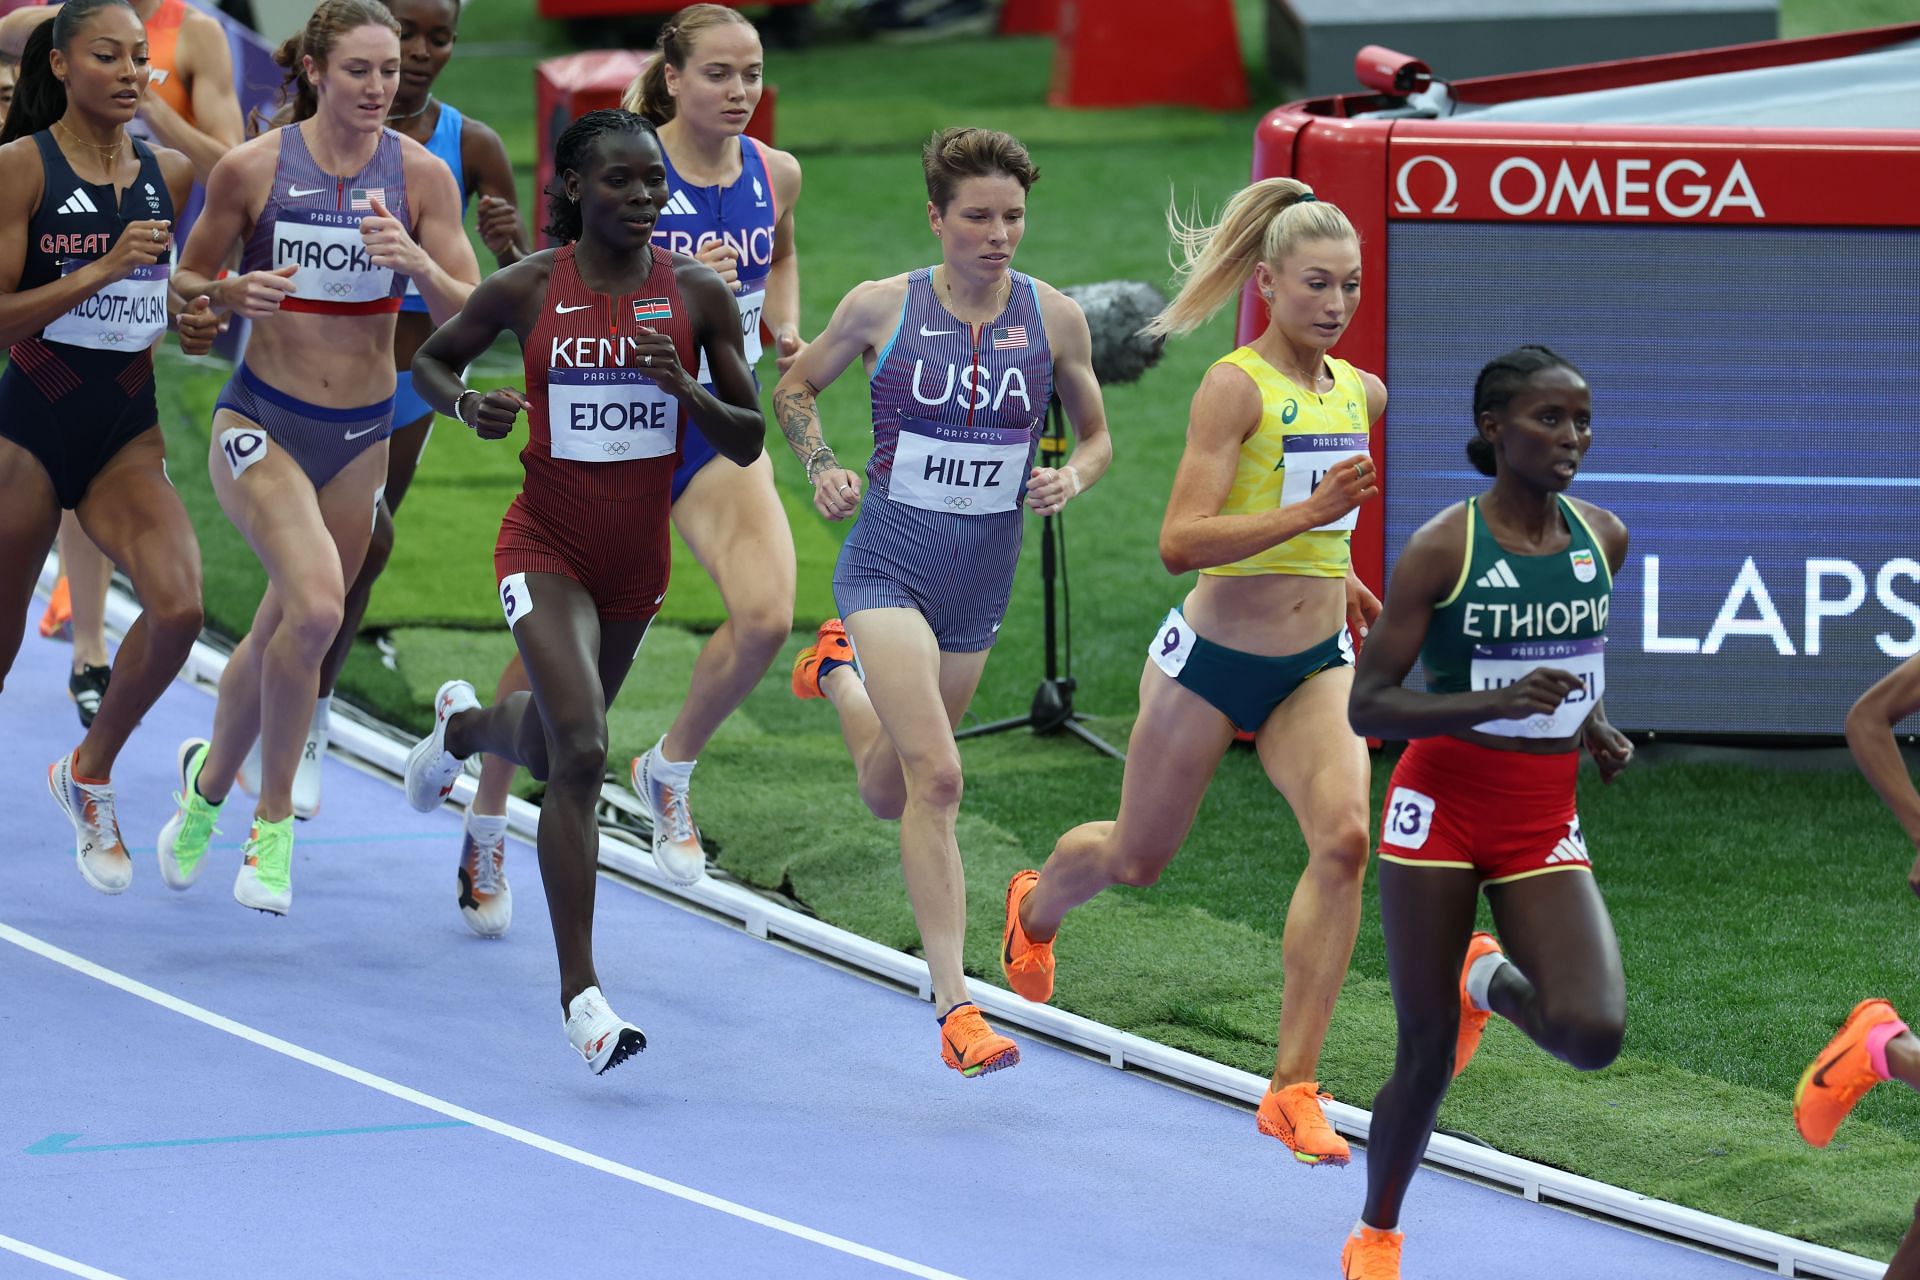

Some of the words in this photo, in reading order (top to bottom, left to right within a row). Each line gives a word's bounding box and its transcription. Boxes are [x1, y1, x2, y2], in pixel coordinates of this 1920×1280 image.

[1489, 156, 1766, 218] OMEGA
[311, 213, 343, 224] PARIS
[347, 216, 362, 225] 20
[40, 233, 110, 254] GREAT
[278, 238, 381, 272] MACK
[68, 292, 165, 324] LCOTT-NOLAN
[550, 336, 638, 368] KEN
[583, 372, 617, 381] PARIS
[621, 372, 650, 381] 202
[912, 359, 1031, 412] USA
[570, 401, 666, 431] EJORE
[936, 426, 969, 439] PARIS
[972, 432, 1003, 441] 2024
[1312, 438, 1338, 447] PARIS
[1340, 437, 1355, 446] 2024
[224, 433, 263, 467] 10
[923, 454, 1004, 487] HILTZ
[502, 583, 516, 617] 5
[1463, 593, 1609, 638] ETHIOPIA
[1643, 554, 1920, 658] LAPS
[1160, 626, 1180, 657] 9
[1511, 646, 1546, 656] PARIS
[1392, 801, 1421, 835] 13
